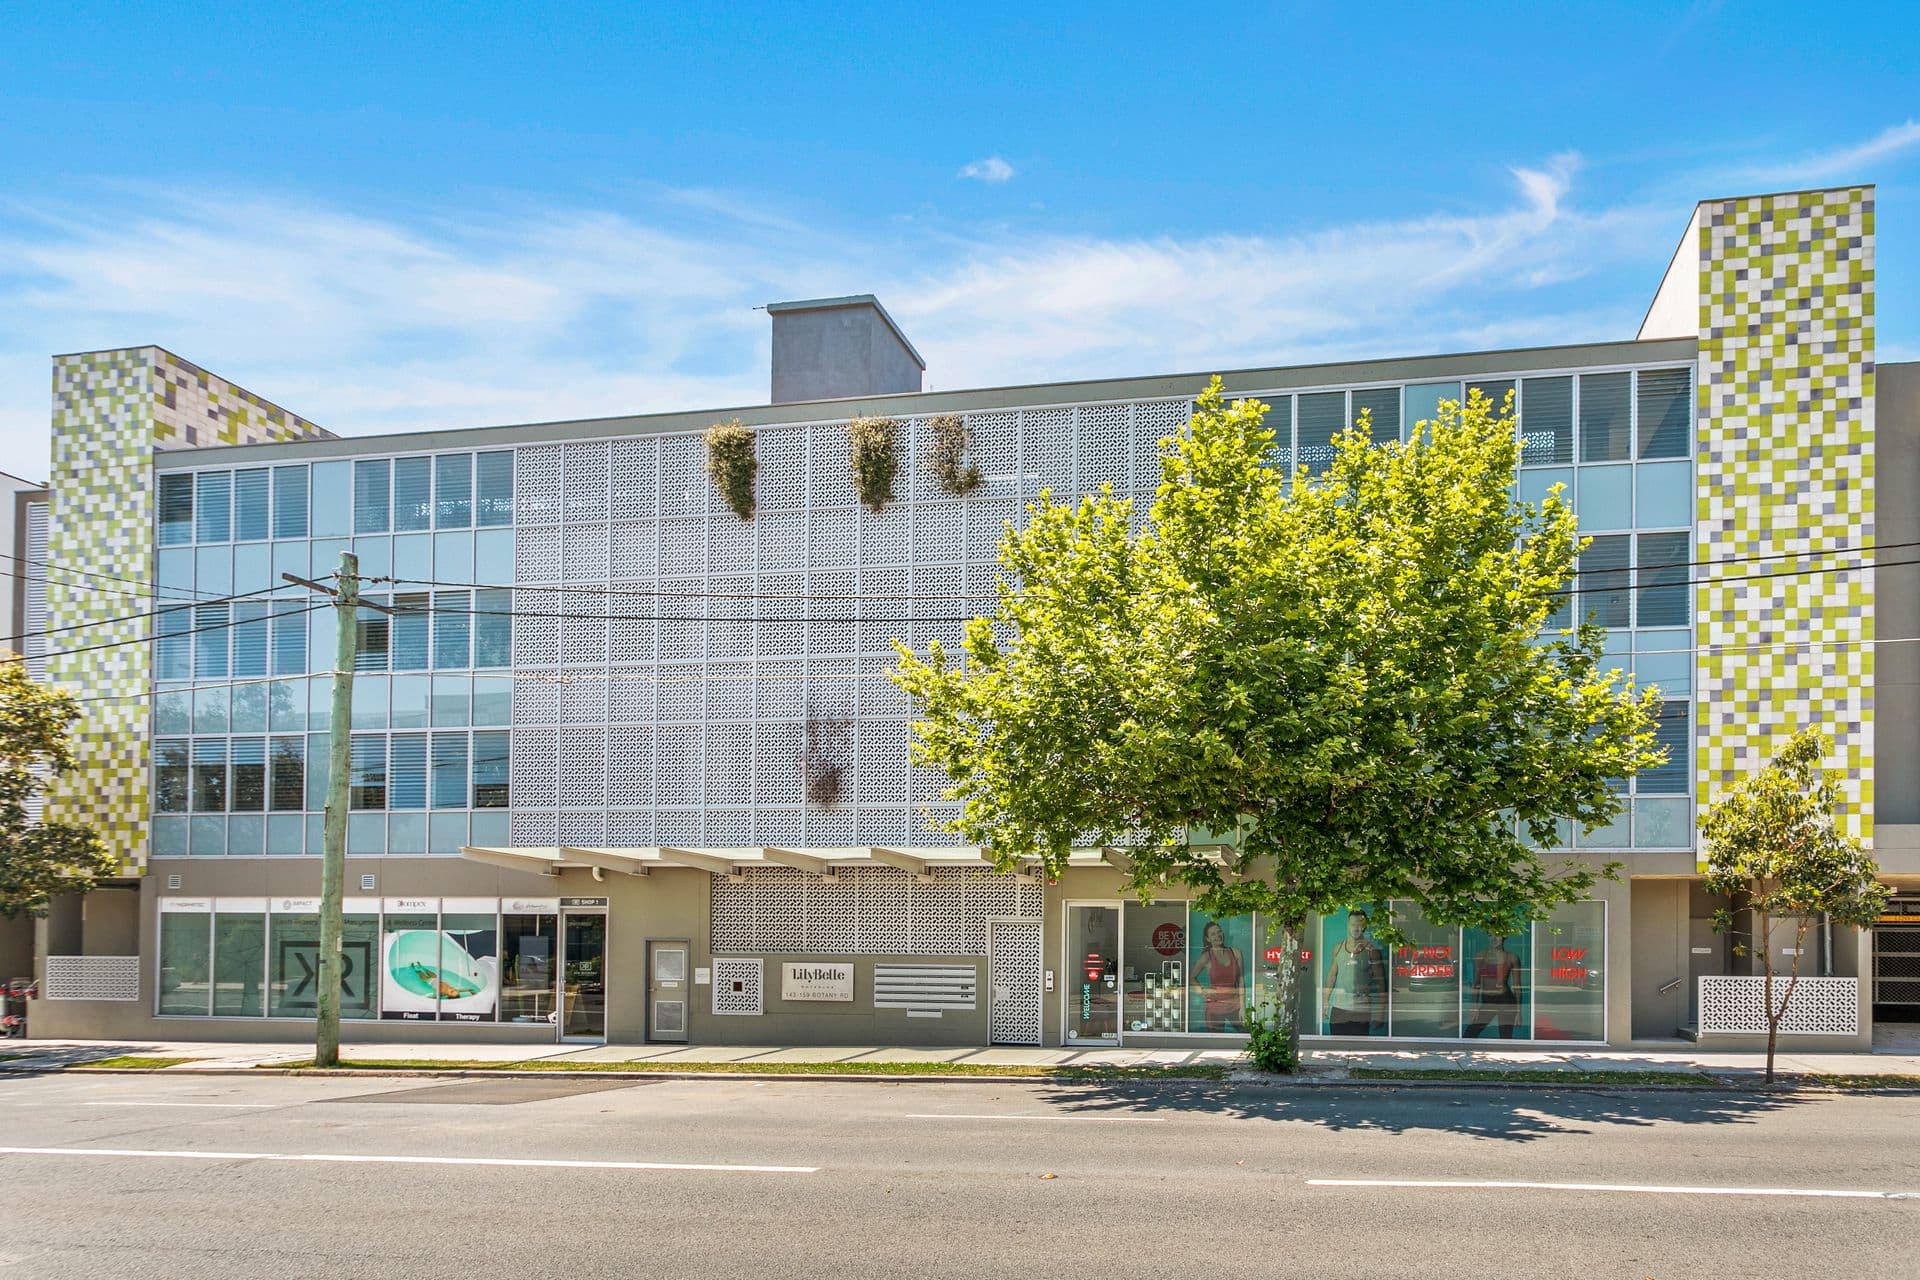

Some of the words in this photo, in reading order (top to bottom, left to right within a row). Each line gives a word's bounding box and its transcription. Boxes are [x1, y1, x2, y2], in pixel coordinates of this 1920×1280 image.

[1159, 931, 1169, 939] BE
[1423, 946, 1453, 959] NOT
[1551, 947, 1588, 961] LOW
[793, 968, 845, 983] LilyBelle
[1396, 965, 1453, 977] HARDER
[1551, 966, 1587, 978] HIGH
[455, 1013, 480, 1022] Therapy
